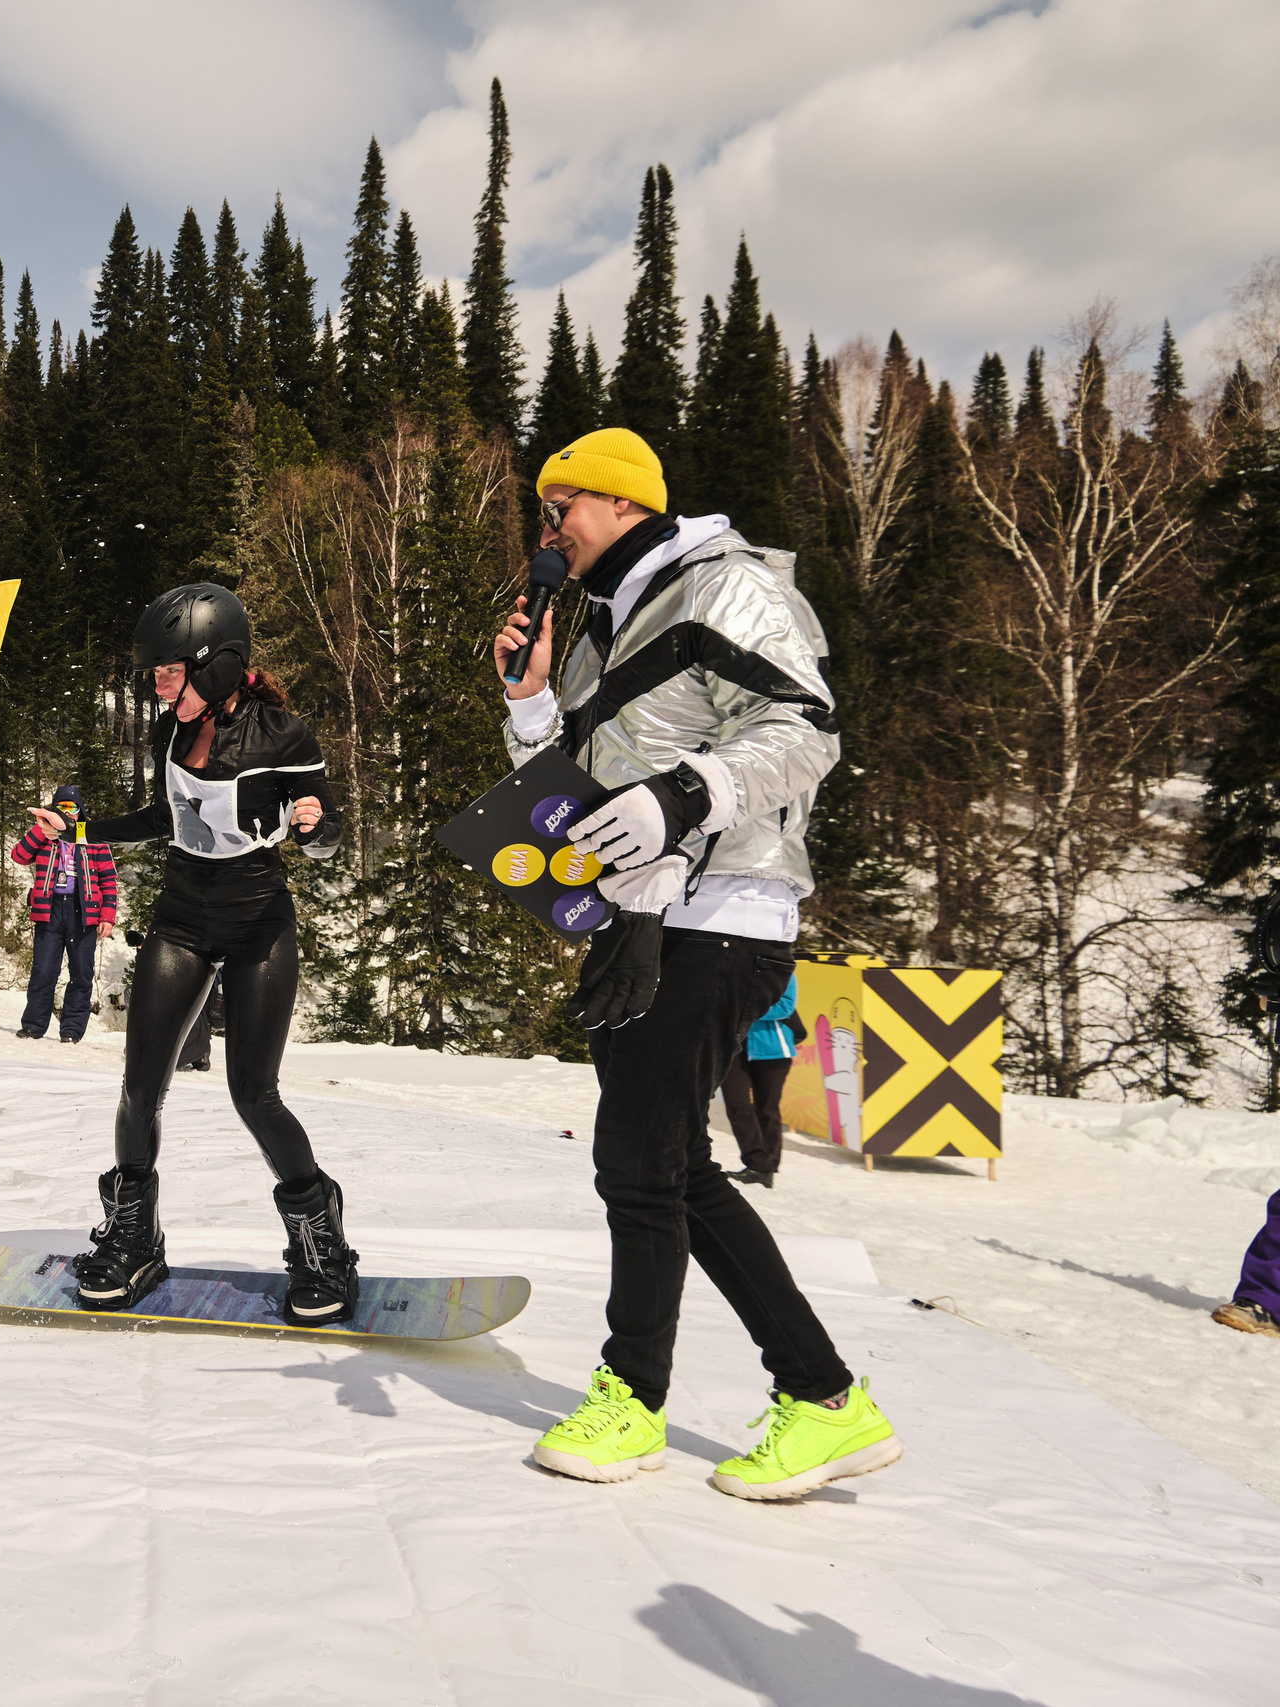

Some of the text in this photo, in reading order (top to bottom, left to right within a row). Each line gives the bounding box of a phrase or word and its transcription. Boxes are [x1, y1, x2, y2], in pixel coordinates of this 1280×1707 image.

[544, 800, 574, 833] ДВИЖ
[564, 895, 595, 926] ДВИЖ
[617, 1421, 631, 1435] FILA
